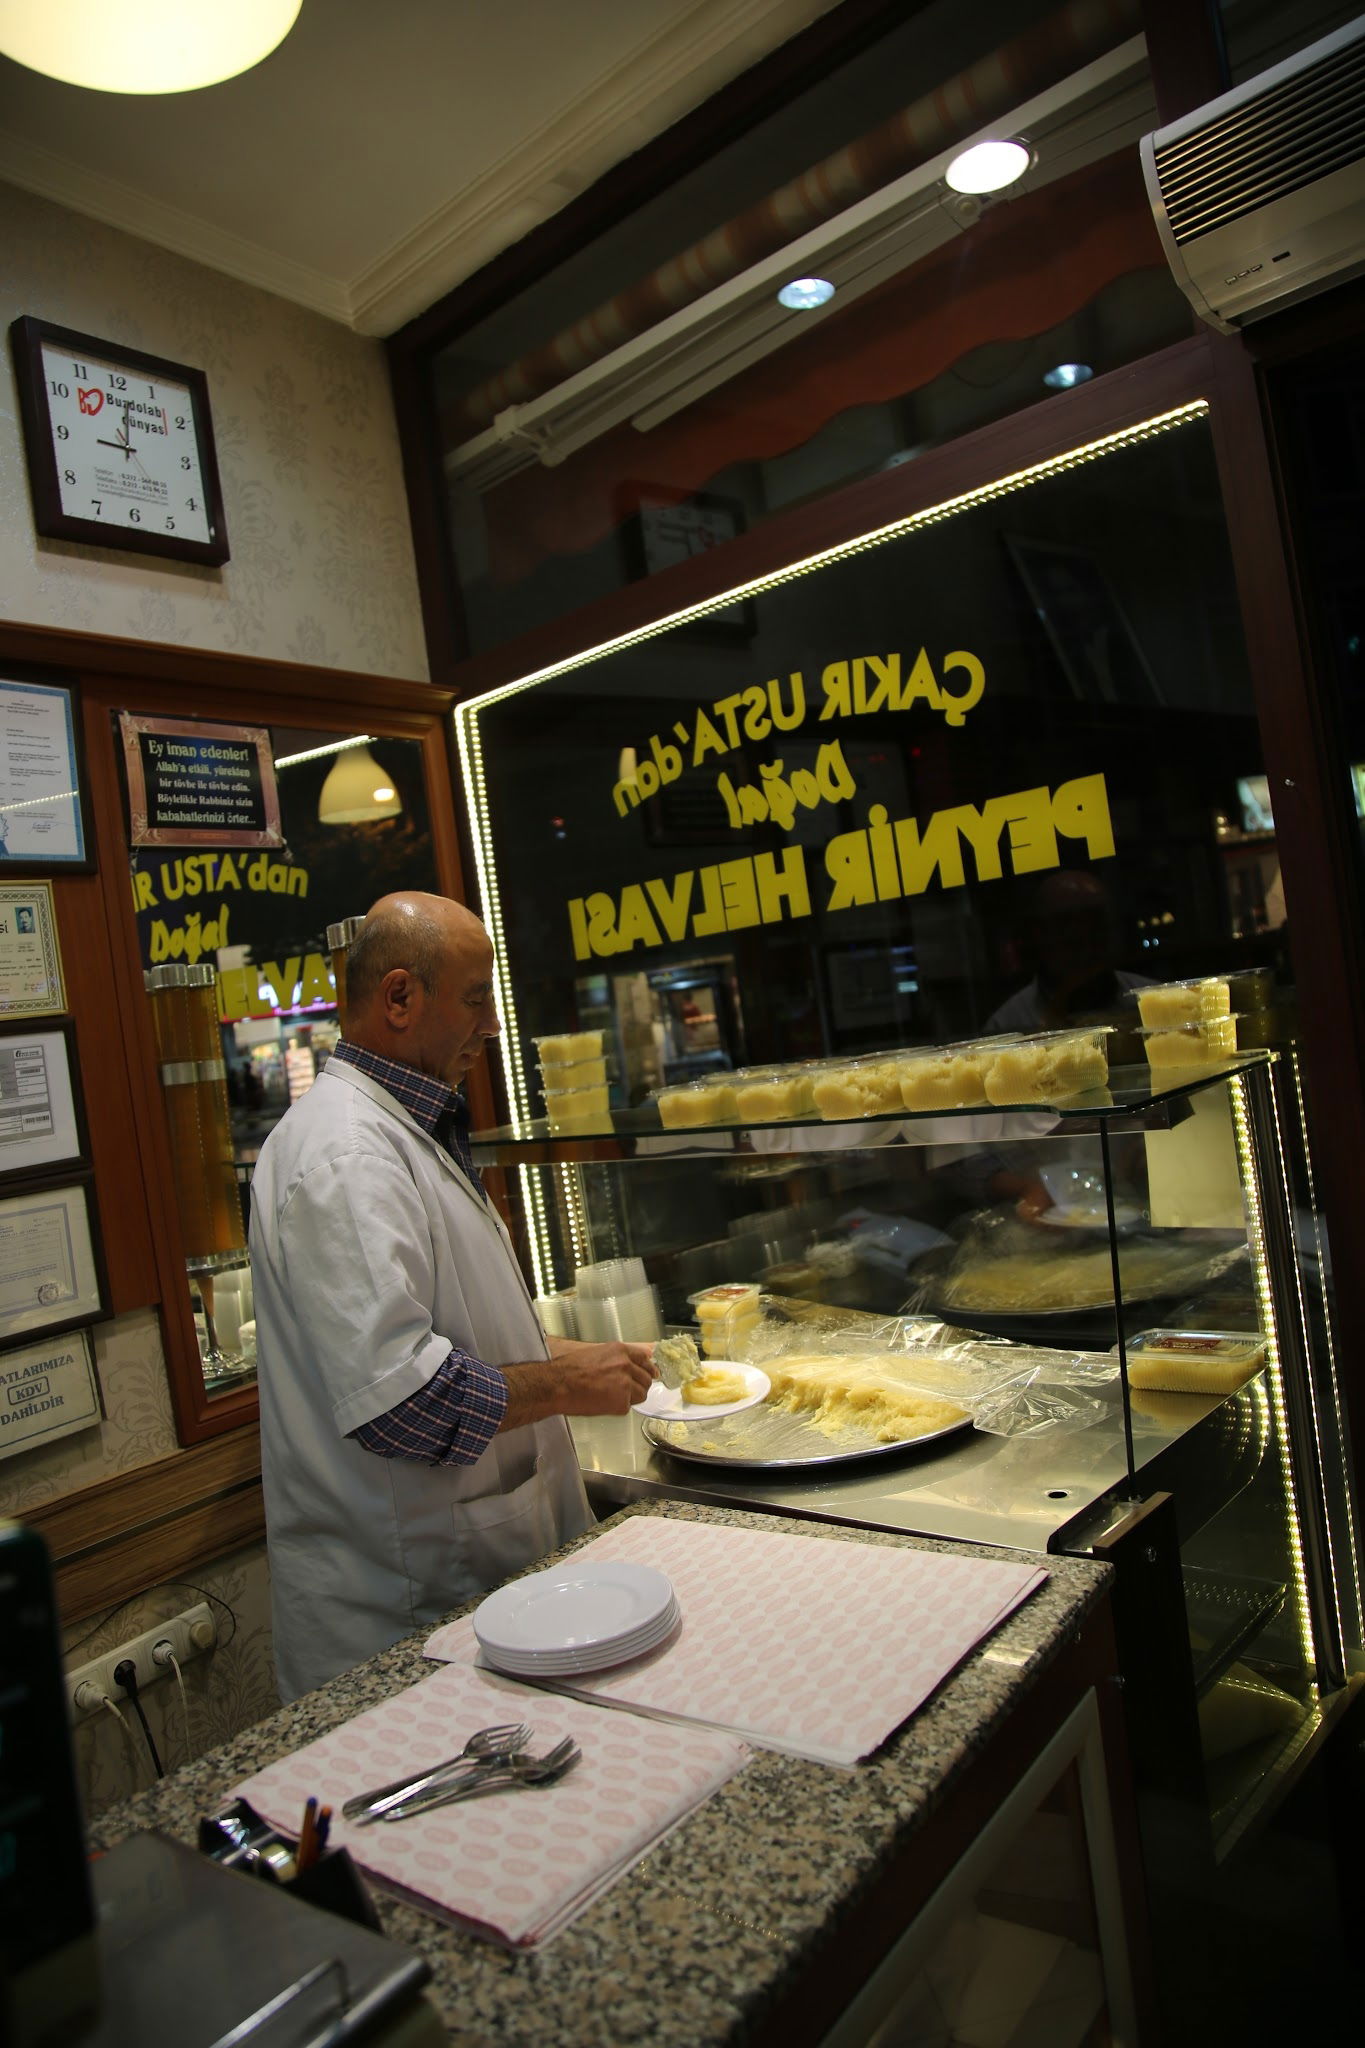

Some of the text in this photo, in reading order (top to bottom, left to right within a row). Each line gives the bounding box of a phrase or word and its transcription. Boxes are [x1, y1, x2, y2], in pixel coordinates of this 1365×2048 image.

[73, 363, 89, 381] 11
[51, 381, 69, 399] 10
[108, 374, 127, 391] 12
[147, 386, 155, 399] 1
[175, 416, 186, 430] 2
[57, 425, 69, 440] 9
[180, 456, 191, 471] 3
[64, 469, 76, 485] 8
[91, 499, 102, 515] 7
[185, 498, 198, 512] 4
[129, 508, 141, 523] 6
[165, 516, 175, 530] 5
[148, 739, 249, 761] Ey iman edenler!
[159, 778, 172, 788] bir
[160, 853, 309, 900] USTA'dan
[150, 903, 229, 965] Doğal
[216, 952, 338, 1022] ELVA
[16, 1383, 42, 1400] KDV
[0, 1395, 64, 1426] DAHİLDİR
